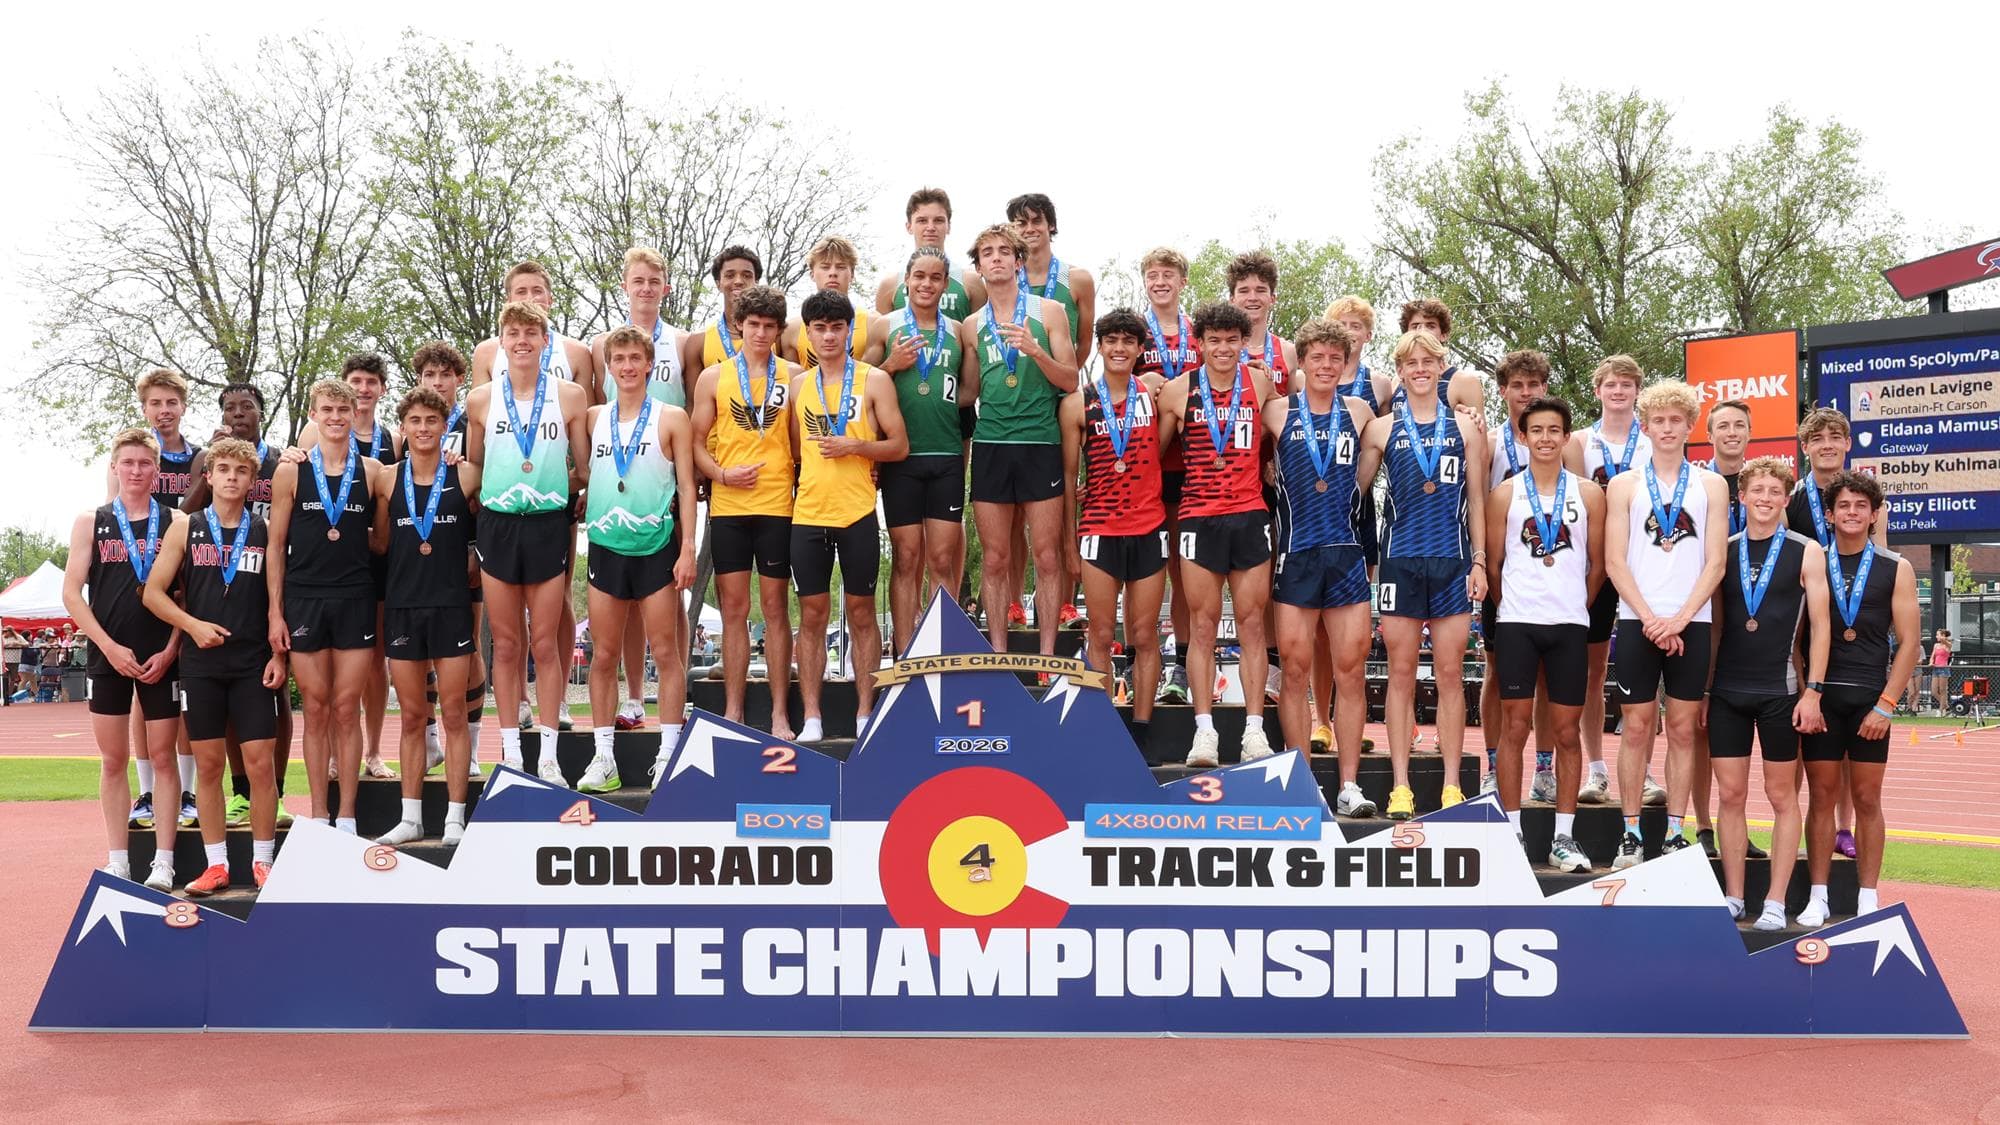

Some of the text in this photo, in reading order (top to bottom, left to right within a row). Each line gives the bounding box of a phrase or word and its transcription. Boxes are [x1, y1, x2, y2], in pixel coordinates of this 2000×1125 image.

[1821, 348, 2000, 375] Mixed 100m SpcOlym/Pa
[654, 365, 671, 382] 10
[774, 385, 786, 406] 3
[946, 376, 955, 401] 2
[1880, 380, 1993, 399] Aiden Lavigne
[1136, 394, 1148, 416] 1
[1829, 398, 1837, 411] 1
[1880, 401, 1943, 416] Fountain-Ft
[1947, 400, 1988, 411] Carson
[541, 422, 558, 440] 10
[1240, 423, 1249, 447] 1
[1881, 419, 2000, 437] Eldana Mamus
[448, 434, 459, 449] 7
[1339, 440, 1351, 463] 4
[1395, 439, 1411, 449] AIR
[1880, 443, 1929, 455] Gateway
[1444, 458, 1456, 482] 4
[1881, 461, 1930, 476] Bobby
[1881, 482, 1928, 494] Brighton
[1566, 501, 1579, 524] 5
[1928, 497, 1976, 511] Elliott
[1887, 518, 1937, 530] ista Peak
[1085, 536, 1094, 558] 1
[1183, 534, 1190, 558] 1
[241, 553, 258, 572] 11
[1382, 585, 1392, 609] 4
[900, 656, 1077, 672] STATE CHAMPION
[957, 700, 983, 727] 1
[938, 738, 1009, 752] 2026
[761, 746, 798, 774] 2
[1188, 777, 1224, 802] 3
[560, 799, 597, 826] 4
[744, 814, 824, 830] BOYS
[1096, 812, 1313, 832] 4X800M RELAY
[1391, 822, 1425, 849] 5
[364, 844, 398, 871] 6
[536, 846, 1481, 888] COLORADO TRACK & FIELD
[959, 844, 996, 868] 4
[1592, 878, 1626, 906] 7
[164, 901, 200, 928] 8
[435, 926, 1559, 998] STATE CHAMPIONSHIPS
[1795, 937, 1831, 965] 9
